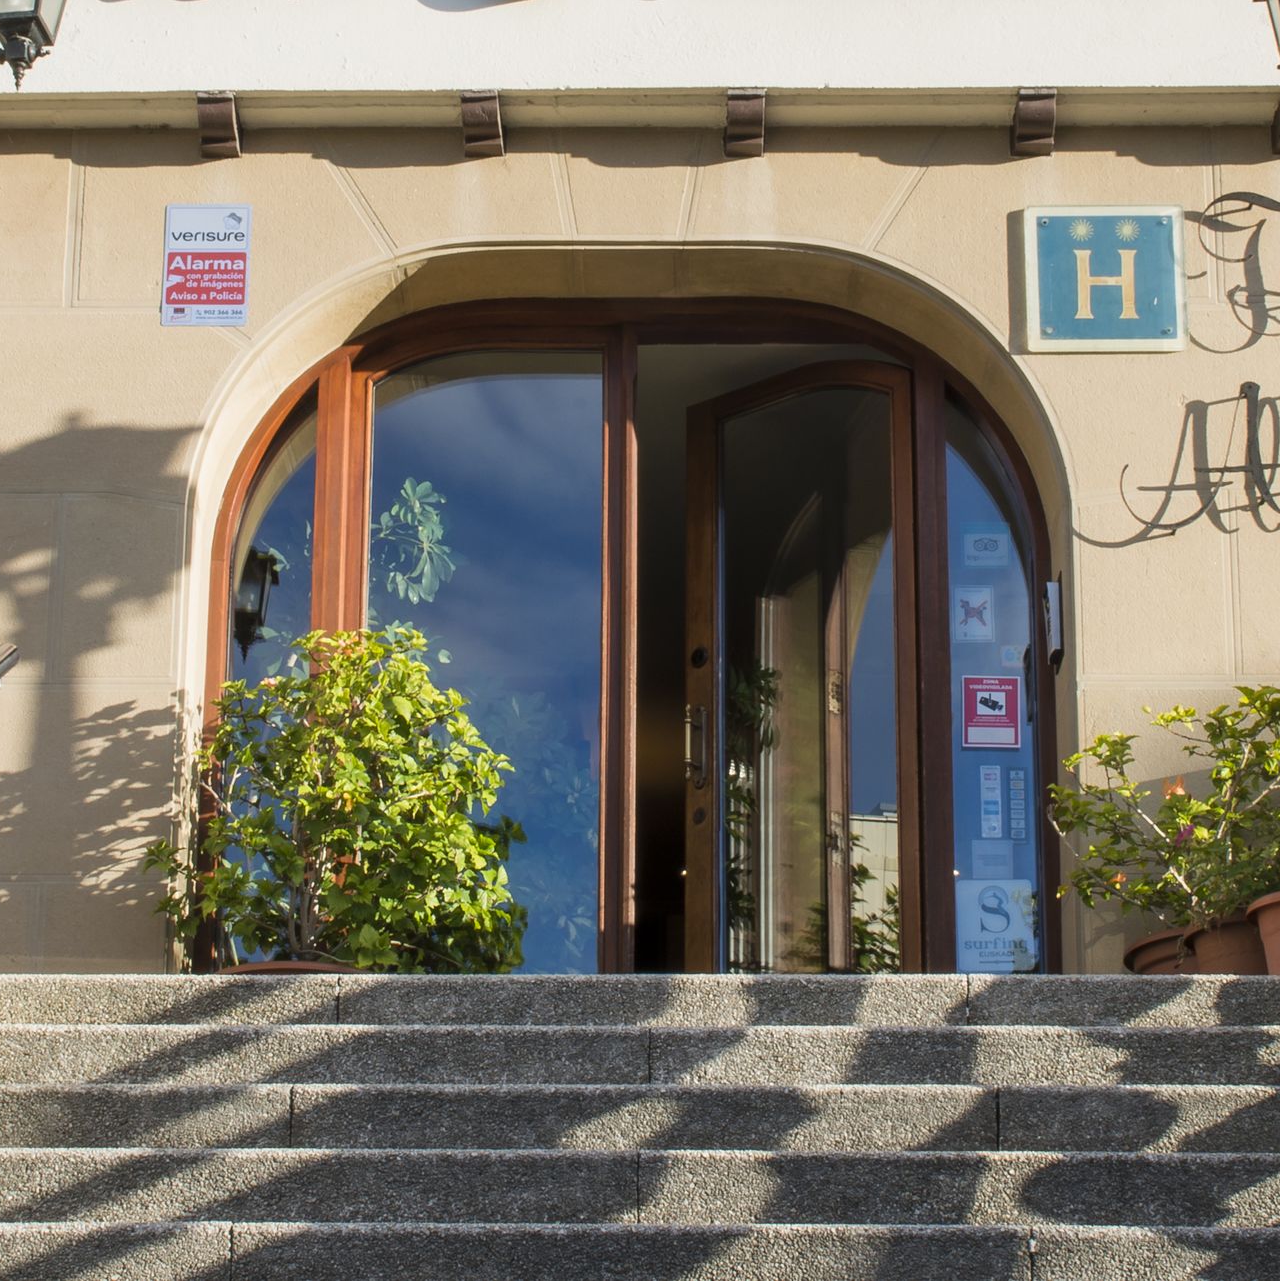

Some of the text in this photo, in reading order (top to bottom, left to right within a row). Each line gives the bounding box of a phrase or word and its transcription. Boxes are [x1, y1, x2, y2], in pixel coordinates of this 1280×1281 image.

[171, 231, 245, 242] verisure
[169, 255, 245, 270] Alarma
[203, 272, 244, 281] grabación
[186, 280, 243, 290] de imágenes
[1073, 248, 1139, 320] H
[170, 291, 198, 300] Aviso
[964, 937, 1028, 954] surfing
